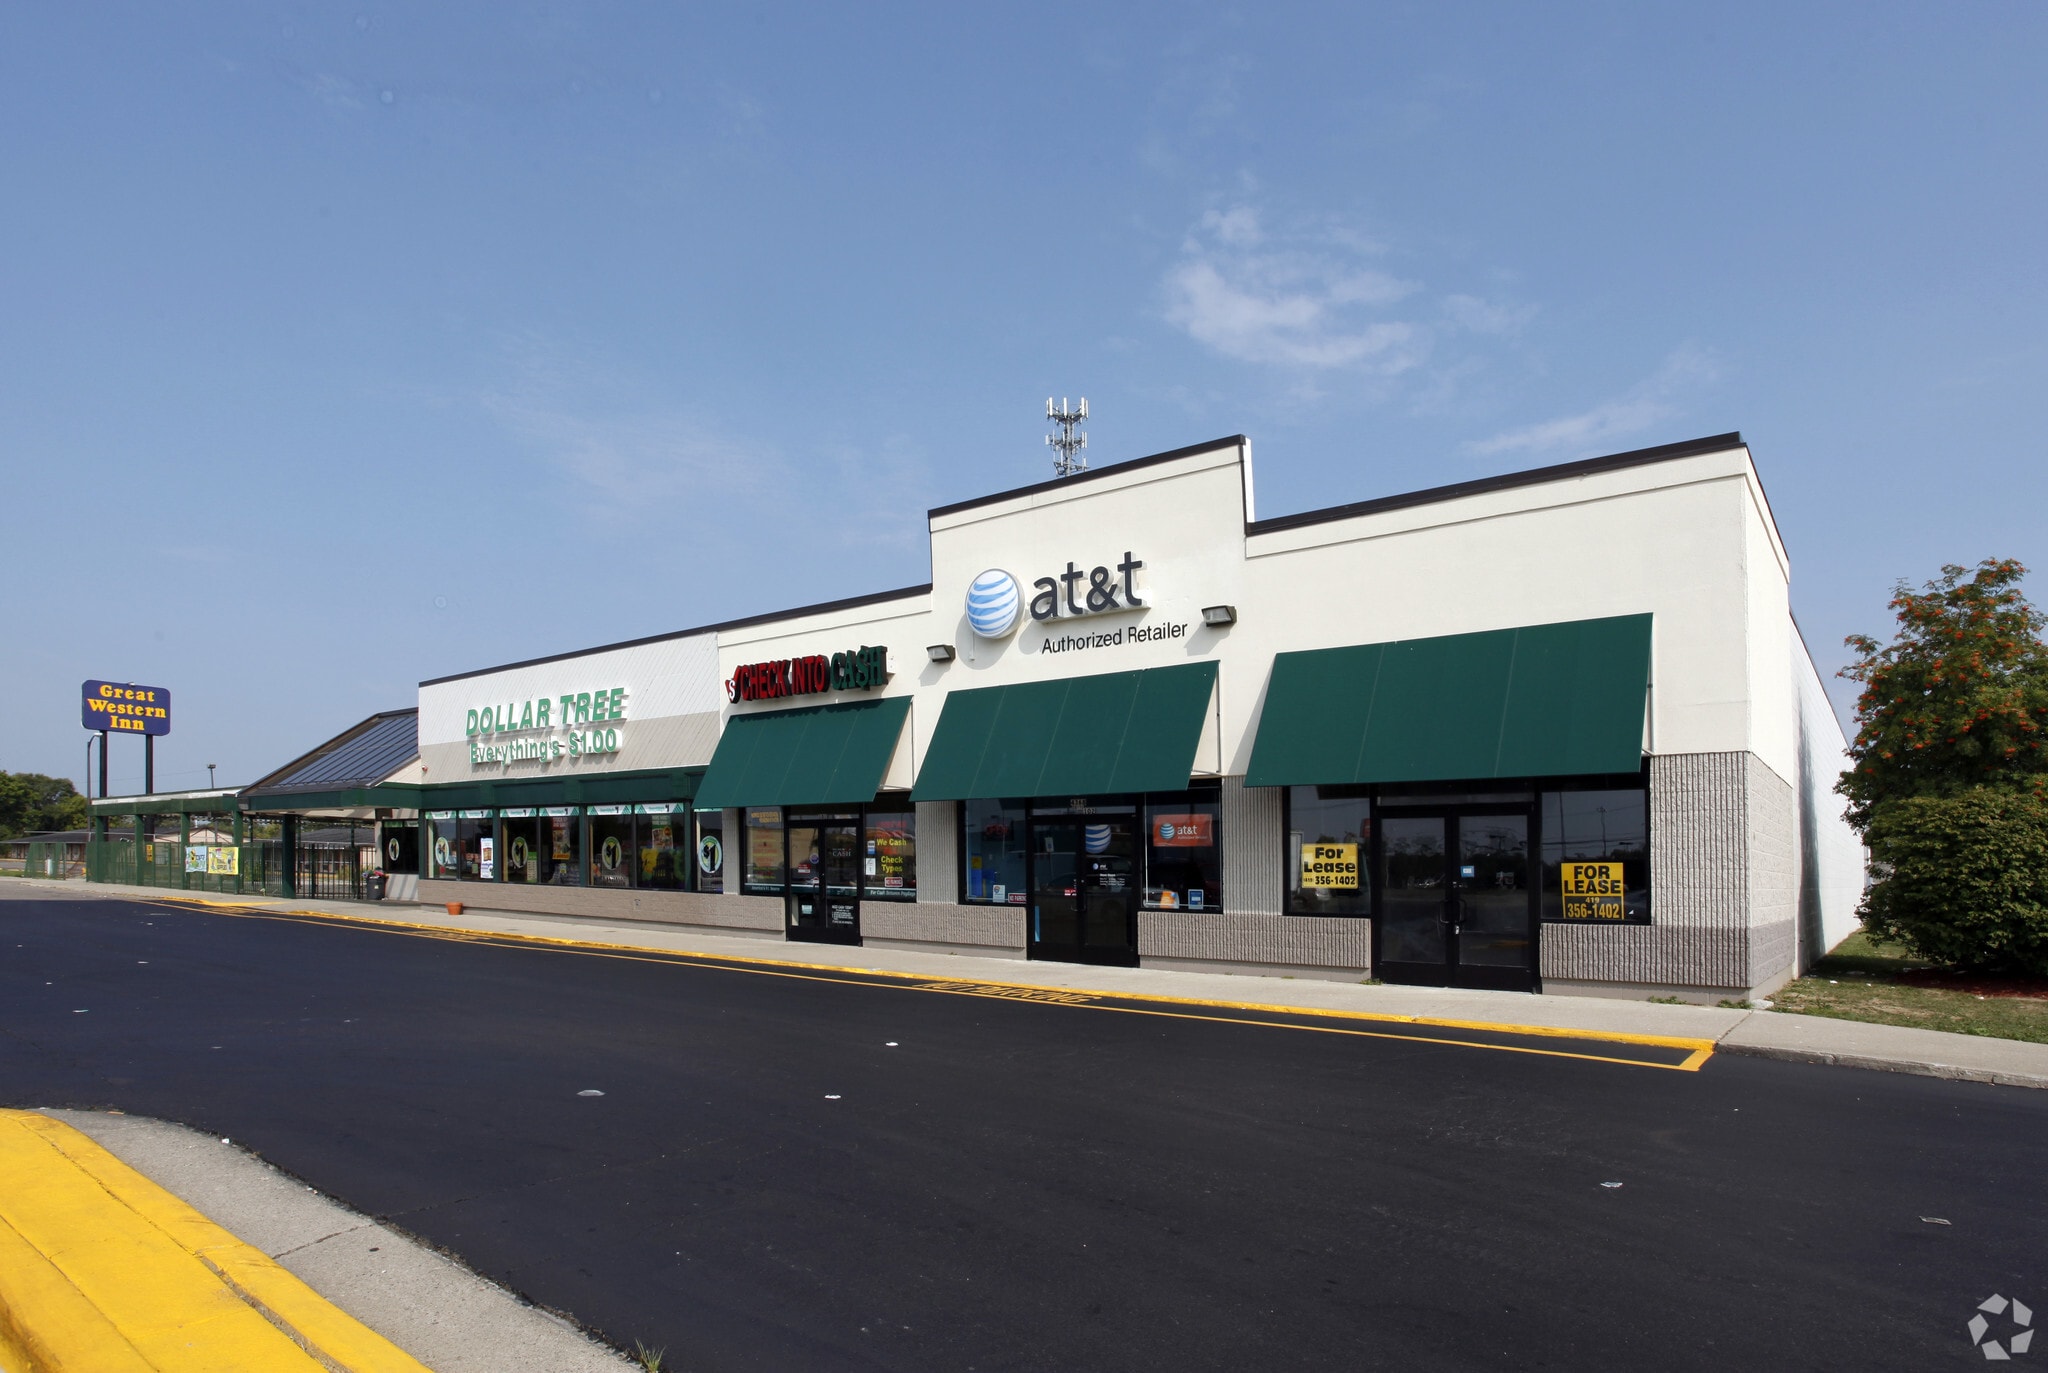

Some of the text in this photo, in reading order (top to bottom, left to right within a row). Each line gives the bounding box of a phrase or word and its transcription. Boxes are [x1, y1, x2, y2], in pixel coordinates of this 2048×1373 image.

[1030, 551, 1143, 620] at&t
[1042, 622, 1188, 654] Authorized Retailer
[741, 659, 788, 701] CHECK
[791, 654, 827, 695] INTO
[99, 684, 155, 702] Great
[87, 698, 167, 718] Western
[466, 687, 625, 736] DOLLAR TREE
[110, 715, 145, 730] Inn
[470, 728, 618, 766] Everything's $1.00
[1177, 825, 1198, 835] at&t
[1315, 847, 1344, 859] For
[881, 864, 903, 873] Types
[1304, 861, 1356, 873] Lease
[1573, 865, 1610, 880] FOR
[1315, 876, 1356, 885] 356-1402
[1564, 880, 1621, 894] LEASE
[1585, 896, 1600, 904] 419
[1567, 903, 1620, 919] 356-1402
